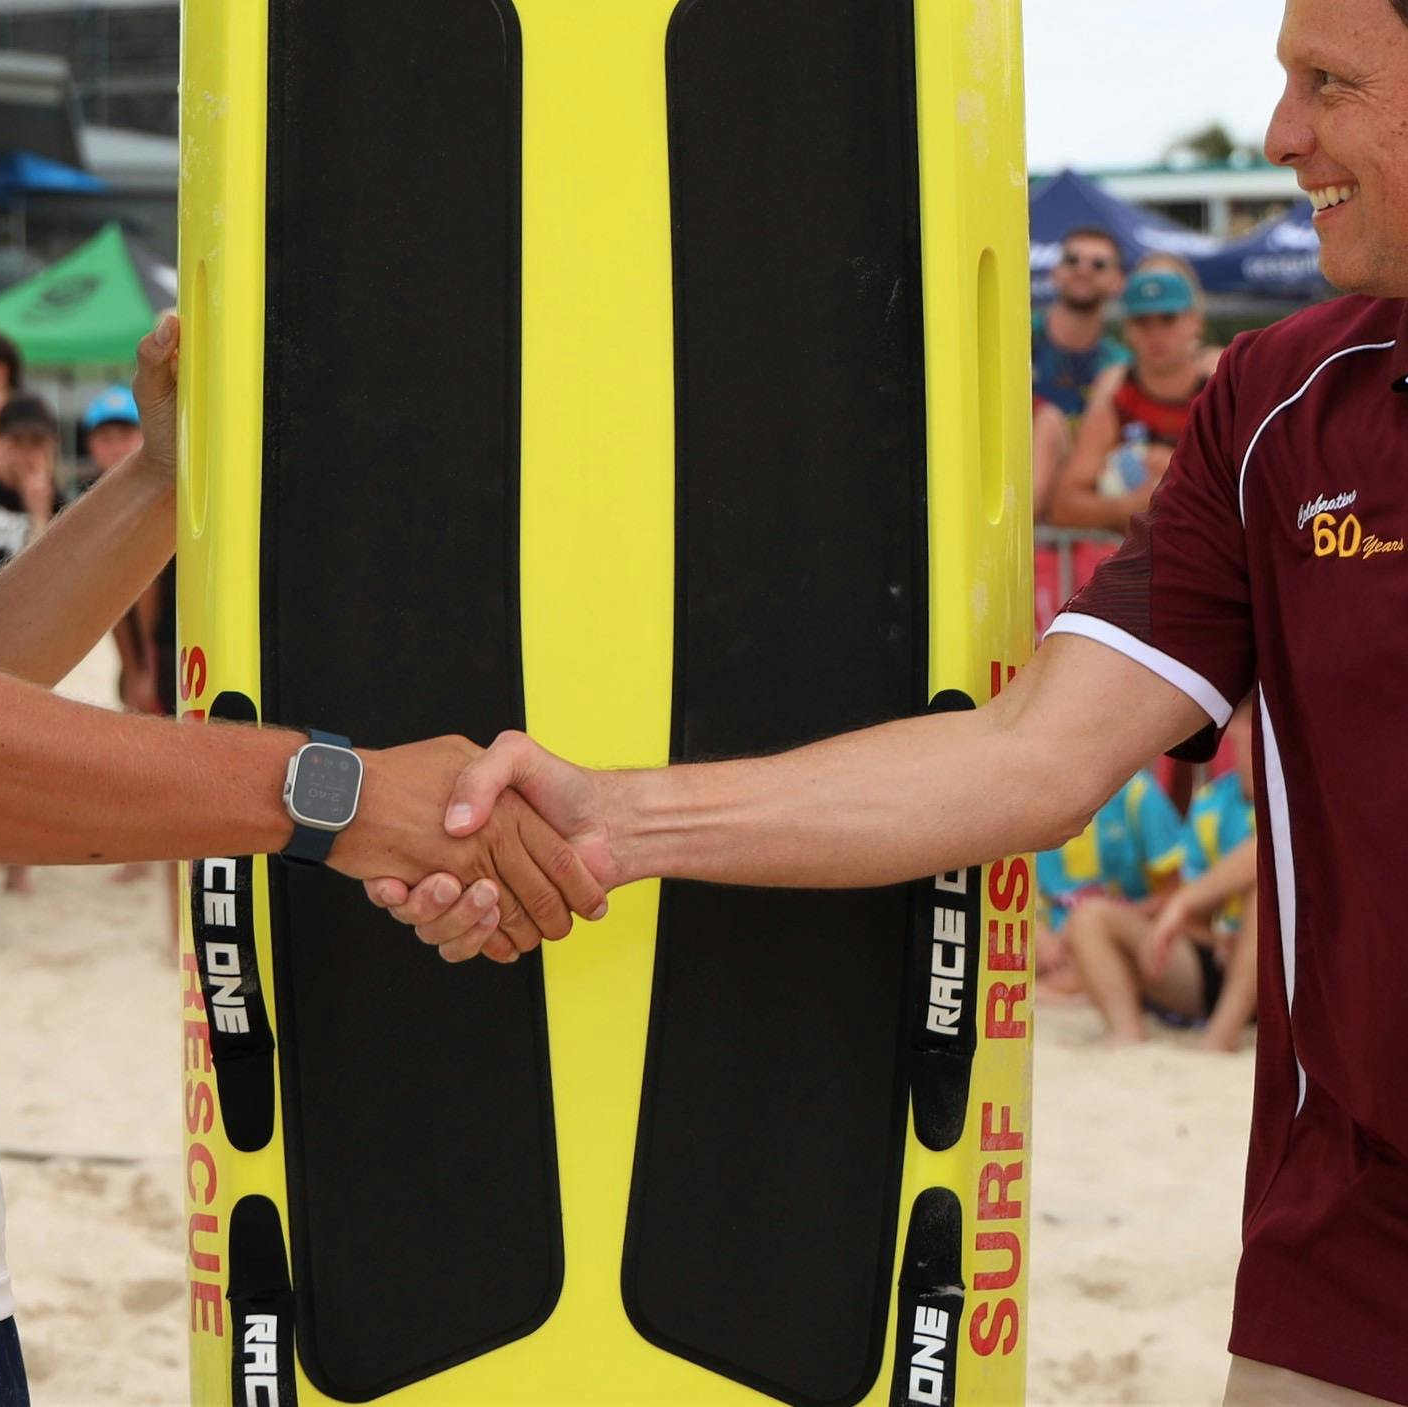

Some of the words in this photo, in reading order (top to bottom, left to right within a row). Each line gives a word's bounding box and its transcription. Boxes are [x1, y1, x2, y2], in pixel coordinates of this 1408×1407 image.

[1312, 512, 1362, 558] 60
[1362, 534, 1405, 561] Years
[203, 857, 237, 927] CE
[204, 942, 250, 1034] ONE
[926, 906, 967, 1036] RACE
[969, 1102, 1025, 1357] SURF
[908, 1305, 950, 1407] ONE
